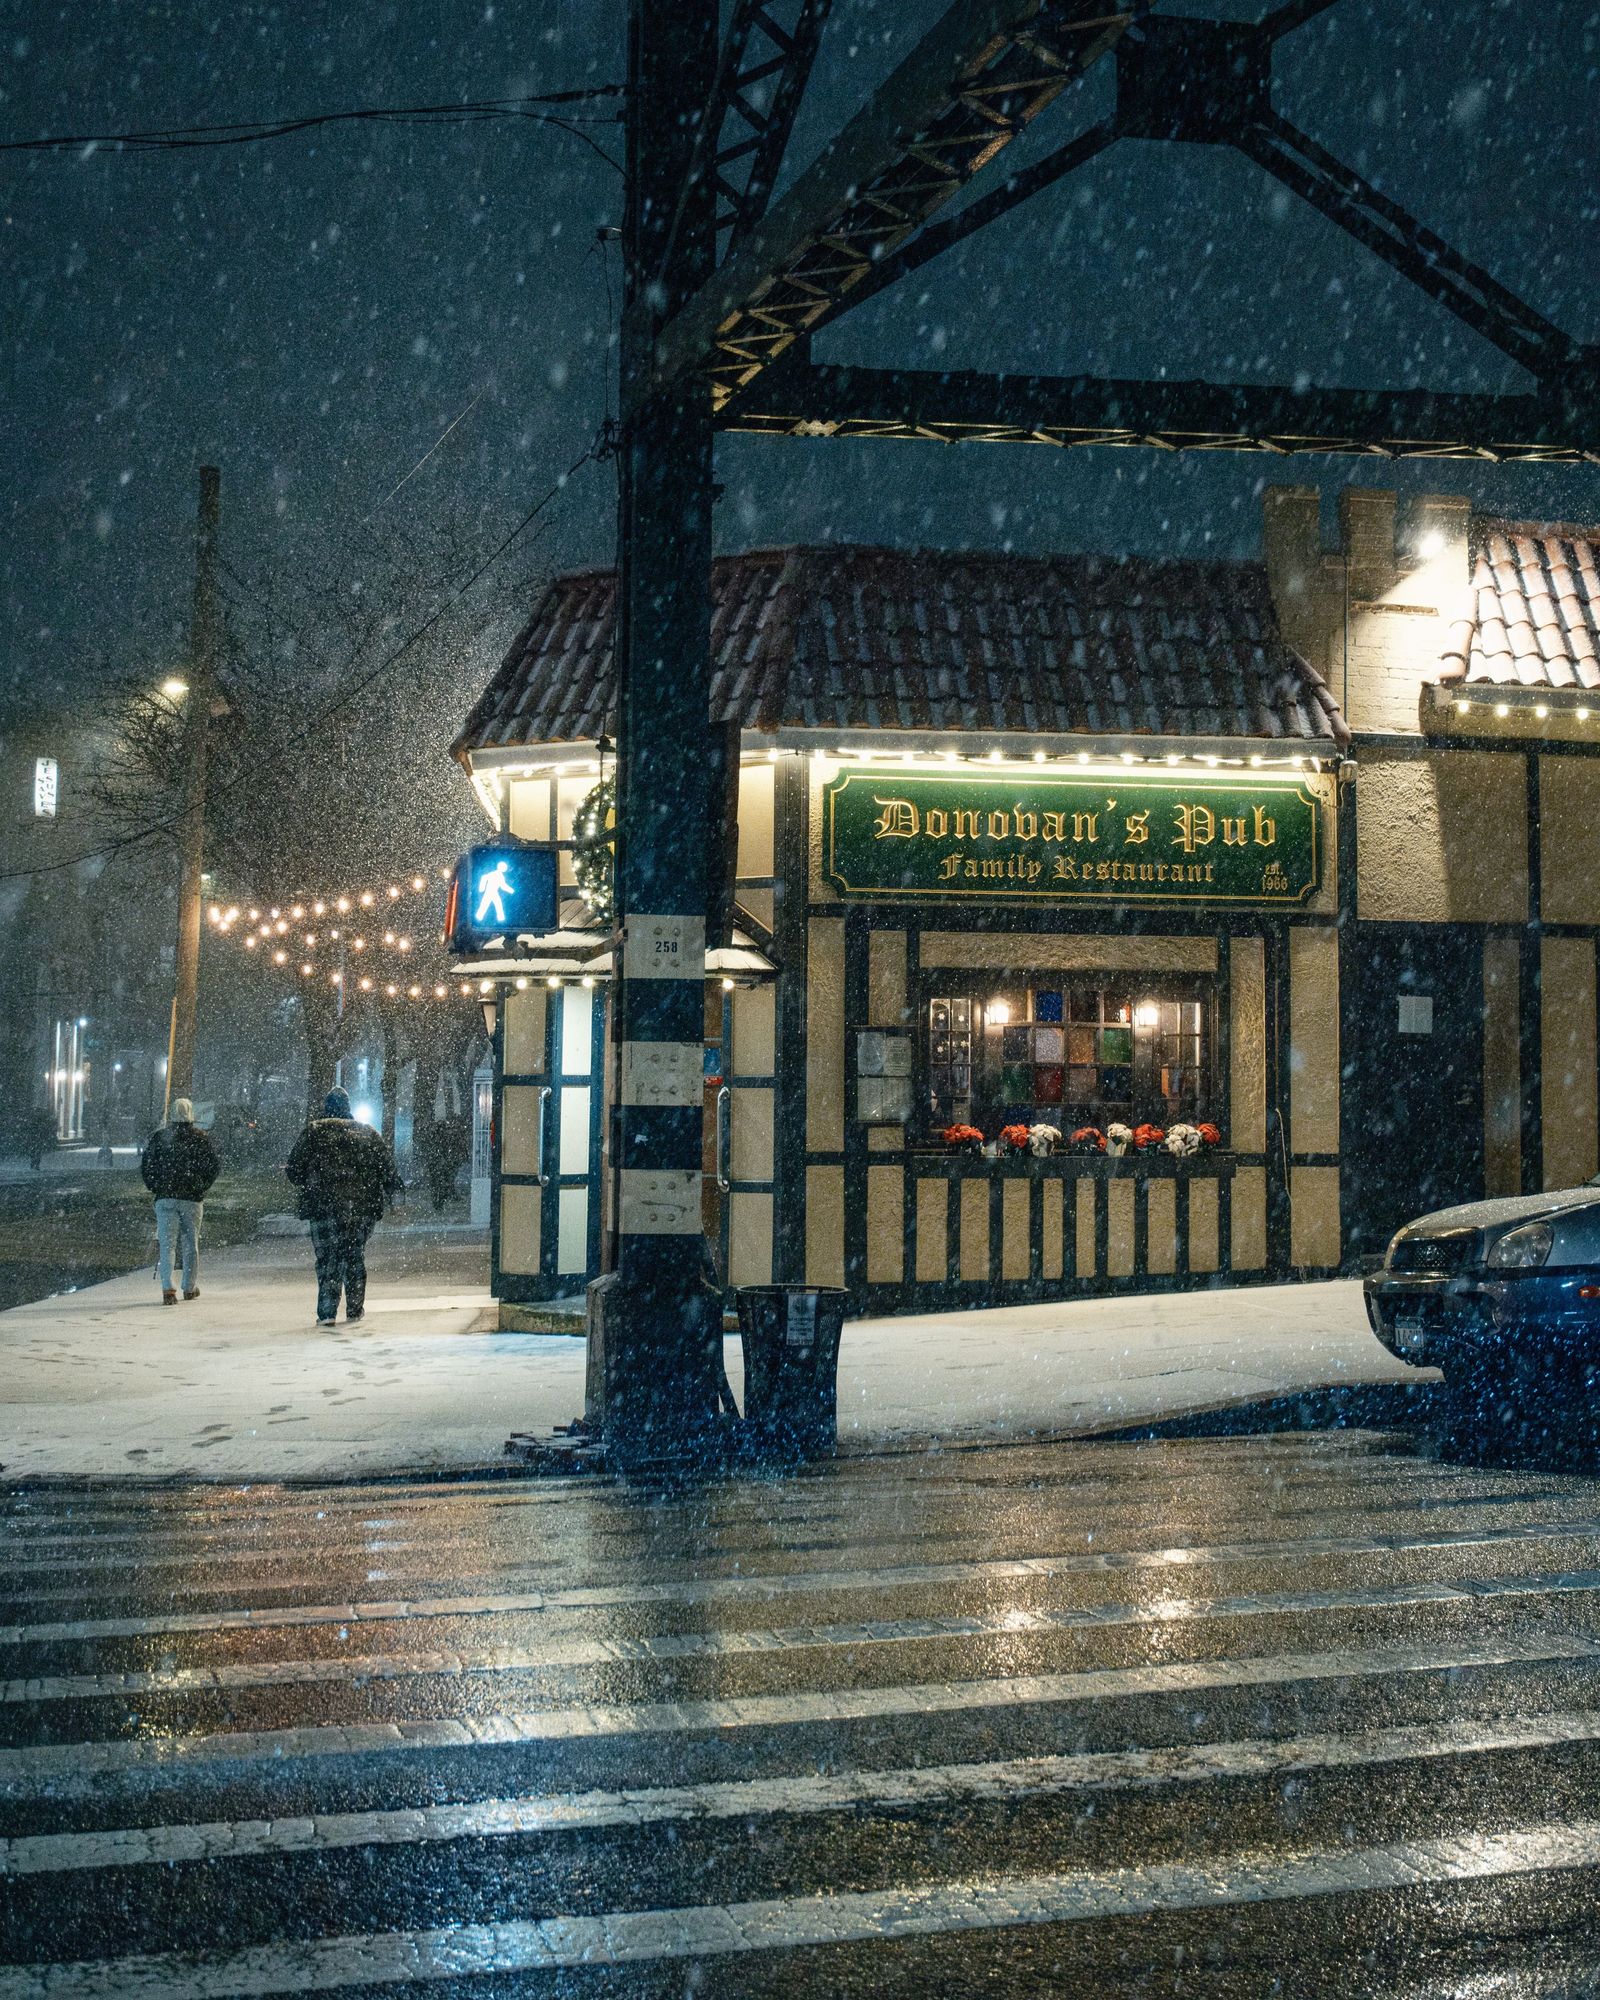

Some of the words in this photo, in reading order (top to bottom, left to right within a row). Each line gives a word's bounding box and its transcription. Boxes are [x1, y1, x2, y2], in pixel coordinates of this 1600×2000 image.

[873, 794, 1151, 844] Donovan's
[1170, 803, 1277, 853] Pub
[938, 853, 1043, 883] Family
[1052, 854, 1215, 883] Restaurant
[1261, 873, 1288, 892] 1966
[655, 941, 678, 953] 258
